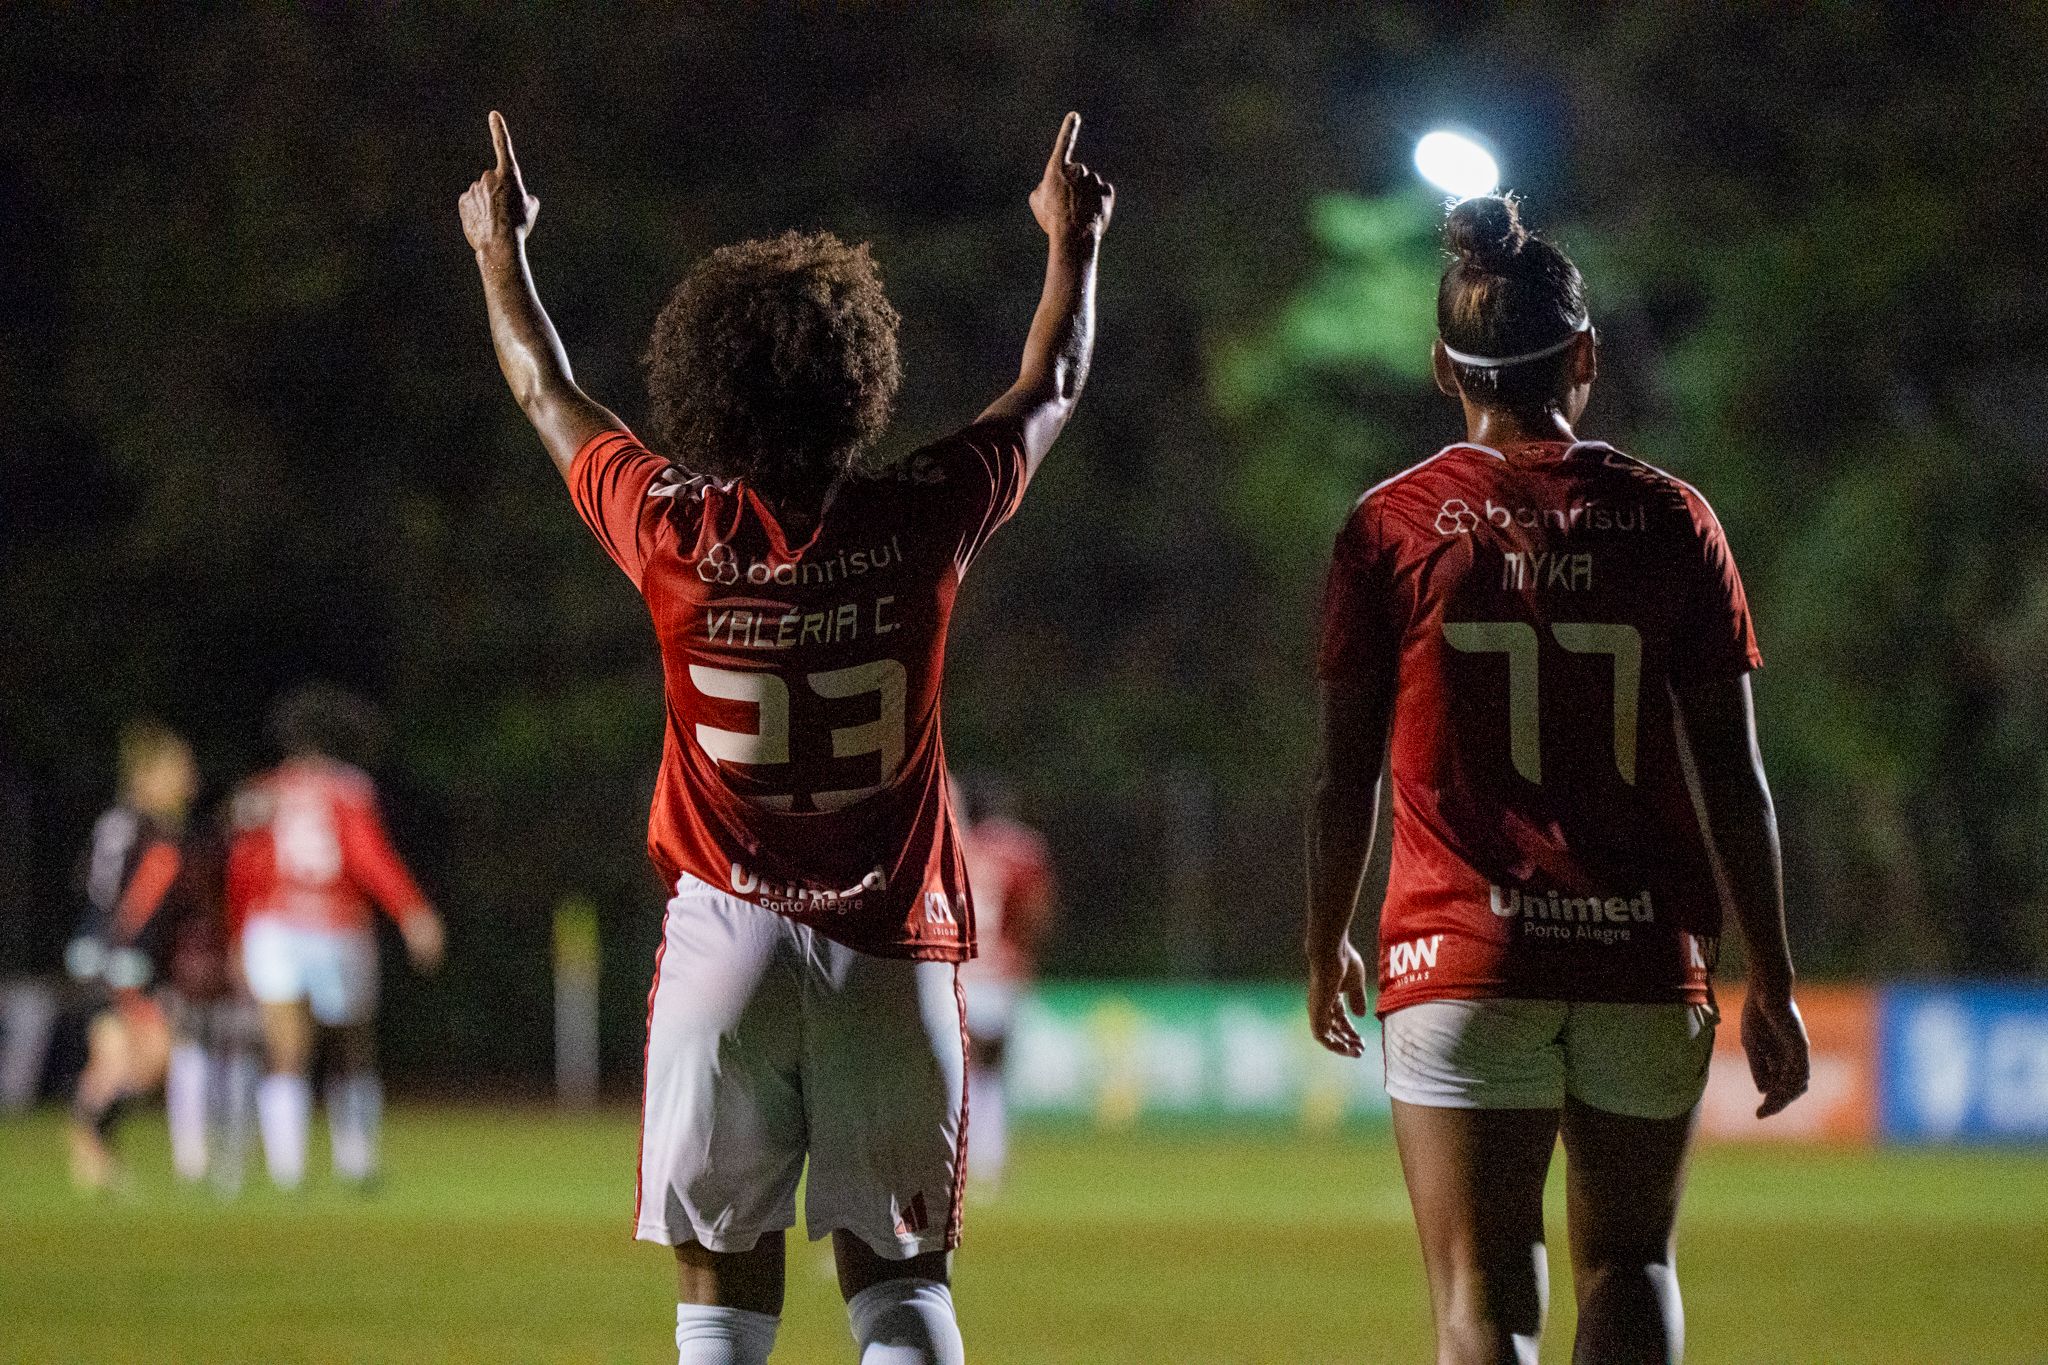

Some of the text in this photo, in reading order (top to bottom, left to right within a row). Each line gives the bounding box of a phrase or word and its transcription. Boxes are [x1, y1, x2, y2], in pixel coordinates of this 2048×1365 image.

[1485, 499, 1647, 532] banrisul
[747, 535, 902, 586] banrisul
[1502, 552, 1592, 592] MYKA
[706, 595, 899, 647] VALÉRIA C.
[1442, 621, 1643, 787] 77
[688, 658, 908, 814] 33
[809, 897, 864, 916] Alegre
[1490, 884, 1654, 923] Unimed
[1524, 921, 1632, 945] Porto Alegre
